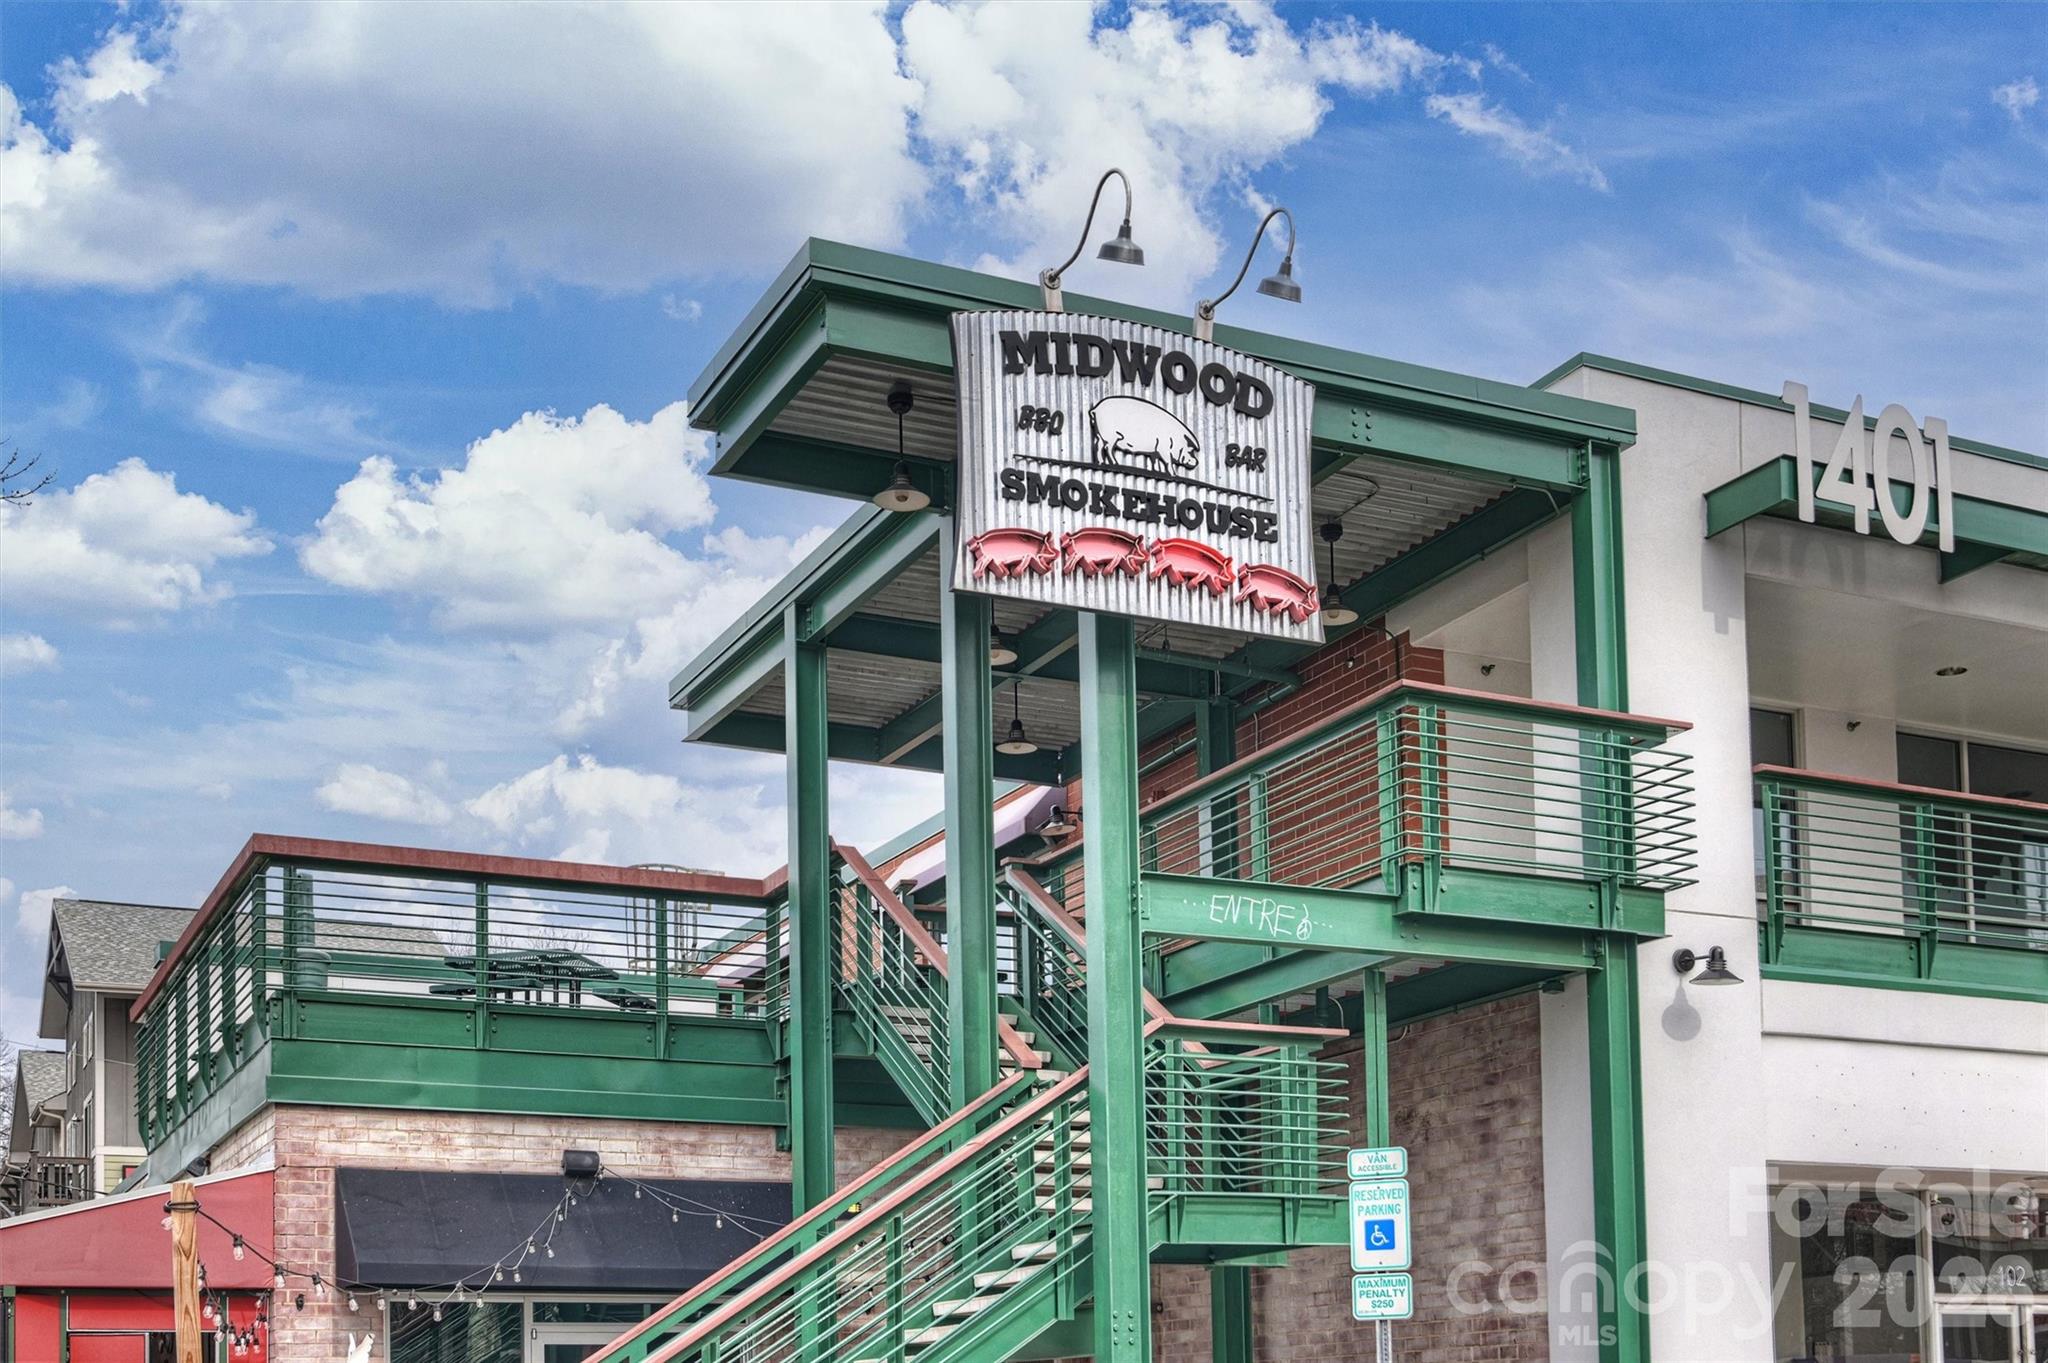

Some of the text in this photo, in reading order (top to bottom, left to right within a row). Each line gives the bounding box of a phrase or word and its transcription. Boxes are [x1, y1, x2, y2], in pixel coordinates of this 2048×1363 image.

[999, 330, 1275, 420] MIDWOOD
[1018, 404, 1065, 436] BBQ
[1224, 442, 1268, 473] BAR
[1782, 380, 1955, 553] 1401
[1000, 467, 1279, 544] SMOKEHOUSE
[1367, 1154, 1388, 1164] VAN
[1357, 1163, 1398, 1172] ACCESSIBLE
[1354, 1188, 1404, 1202] RESERVED
[1357, 1203, 1401, 1217] PARKING
[1999, 1265, 2027, 1287] 102
[1357, 1279, 1407, 1289] MAXIMUM
[1359, 1289, 1406, 1299] PENALTY
[1370, 1299, 1395, 1309] $250
